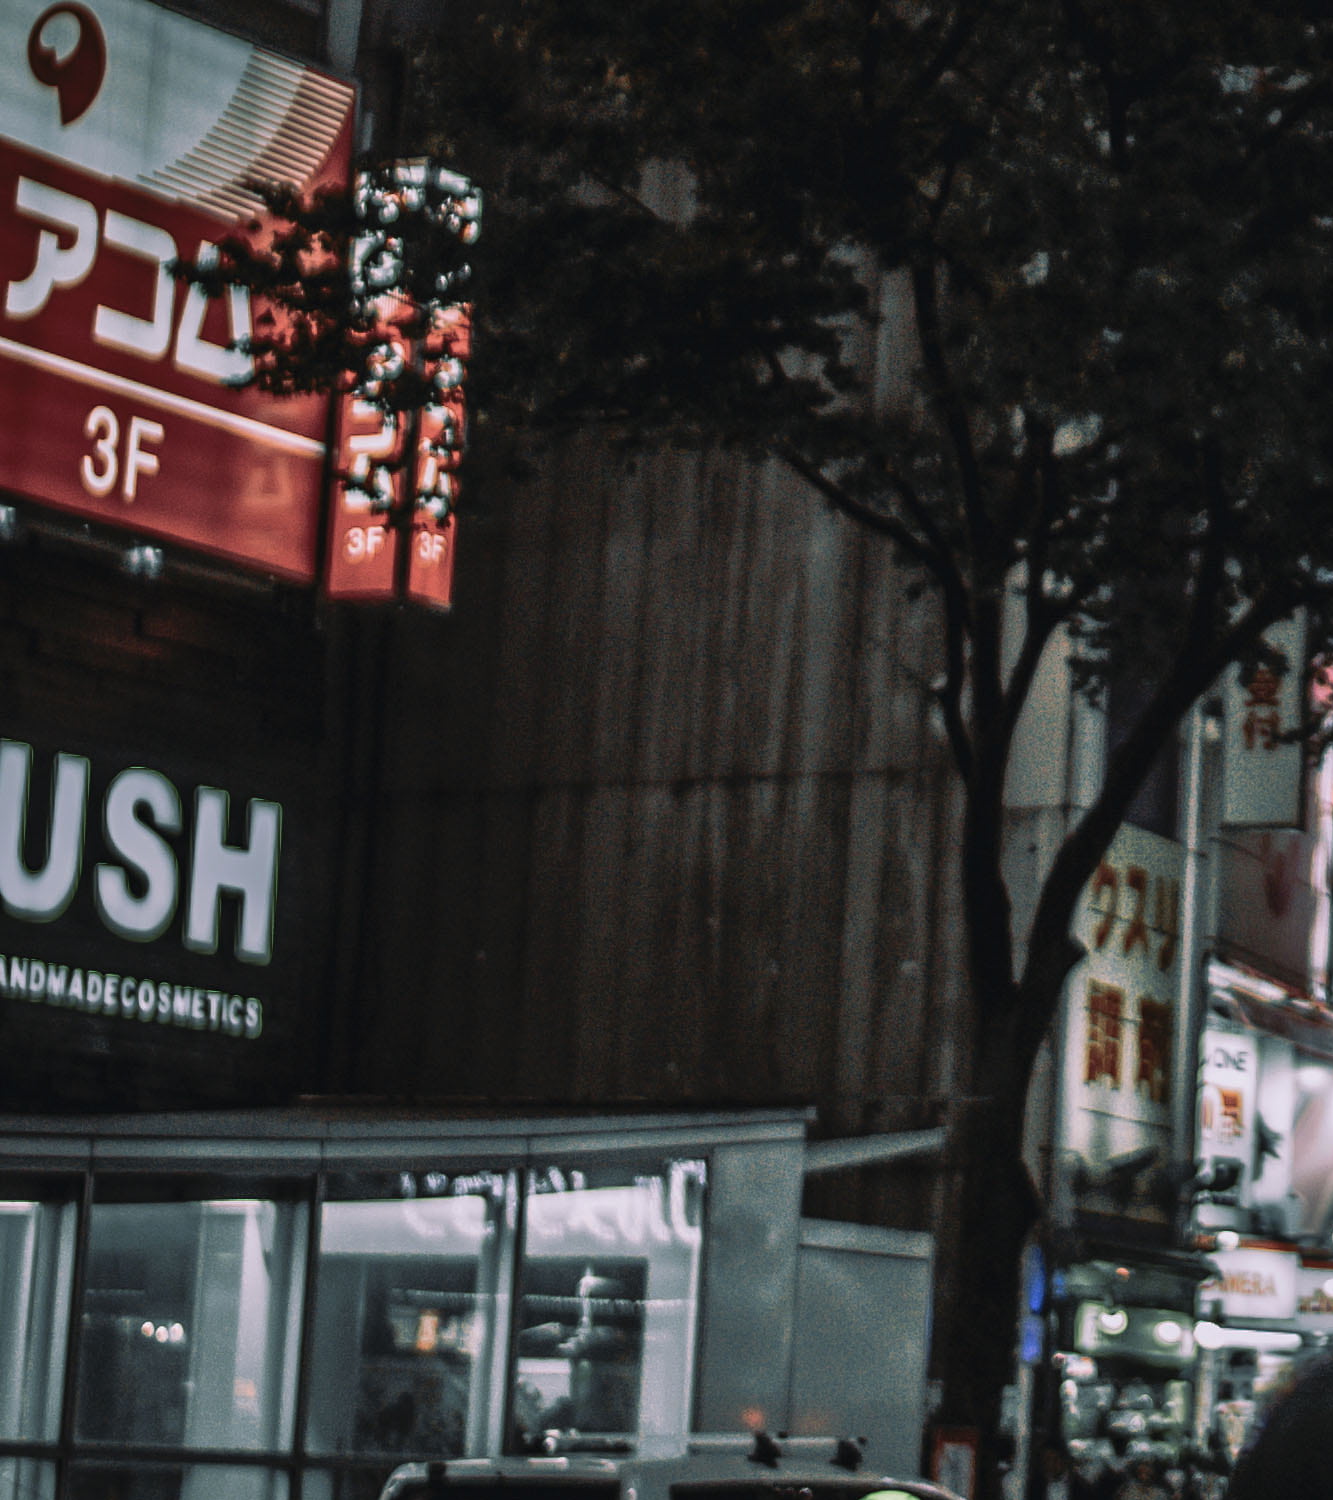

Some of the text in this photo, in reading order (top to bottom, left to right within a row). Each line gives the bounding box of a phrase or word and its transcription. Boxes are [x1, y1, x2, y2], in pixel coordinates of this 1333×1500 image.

[80, 404, 166, 502] 3F
[346, 525, 385, 564] 3F
[417, 529, 447, 569] 3F
[0, 738, 283, 966] USH
